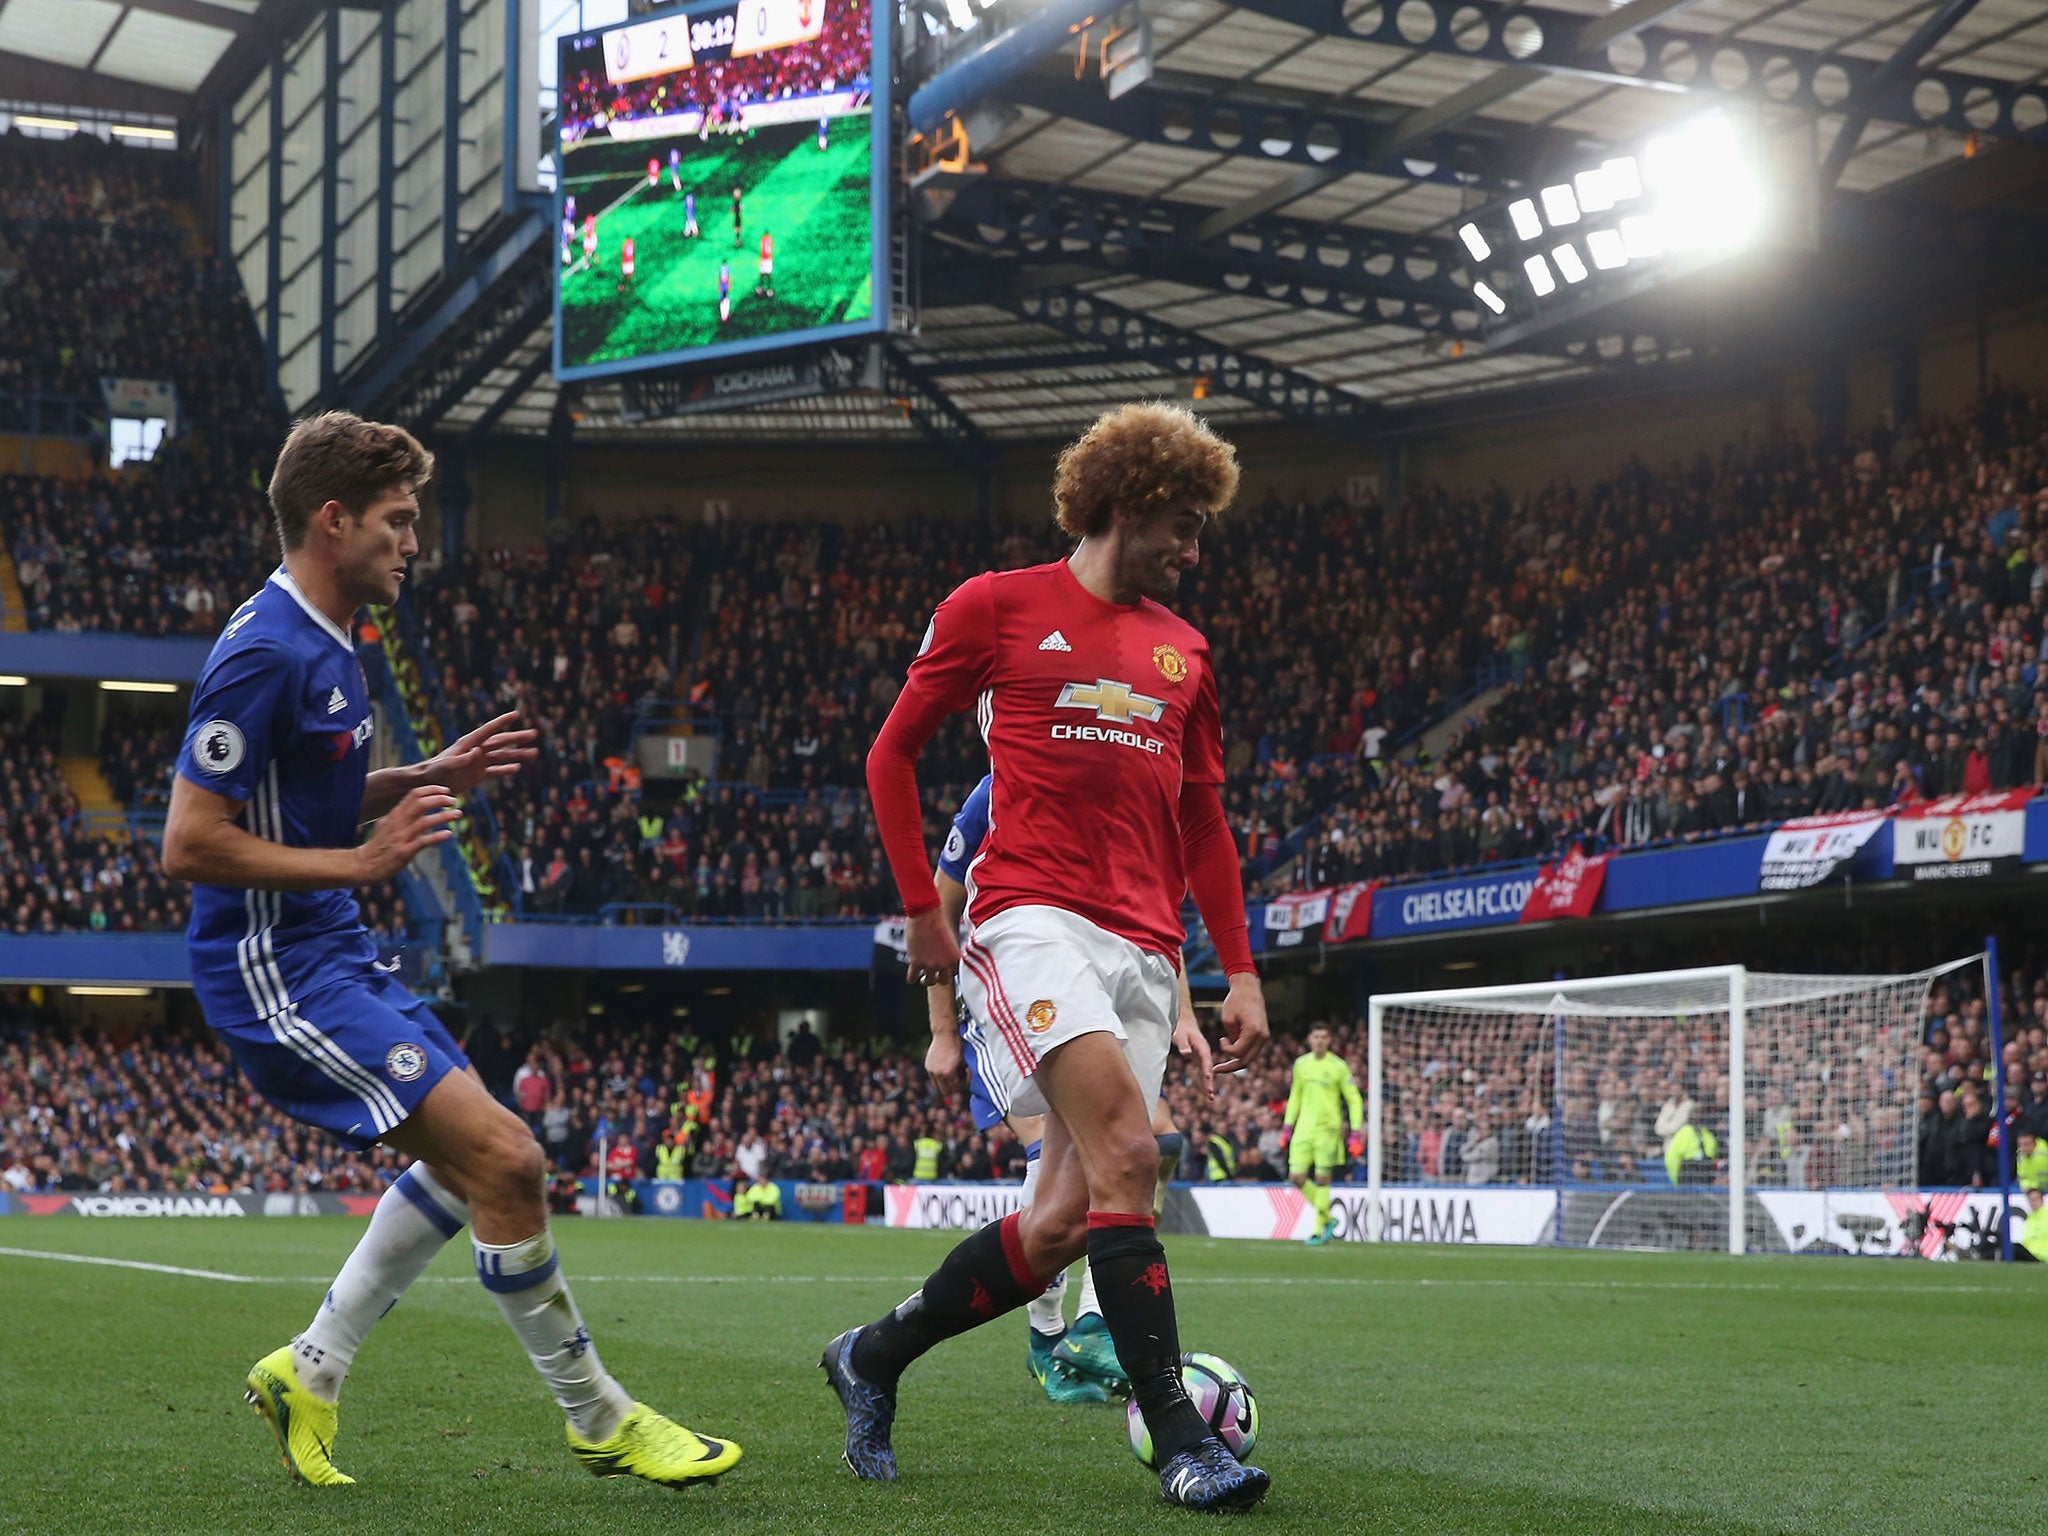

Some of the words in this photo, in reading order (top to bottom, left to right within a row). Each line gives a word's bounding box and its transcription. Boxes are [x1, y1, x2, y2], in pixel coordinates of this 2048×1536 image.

[1038, 642, 1072, 652] adidas
[1051, 725, 1164, 755] CHEVROLET
[71, 1197, 246, 1217] YOKOHAMA
[1329, 1197, 1478, 1242] OKOHAMA
